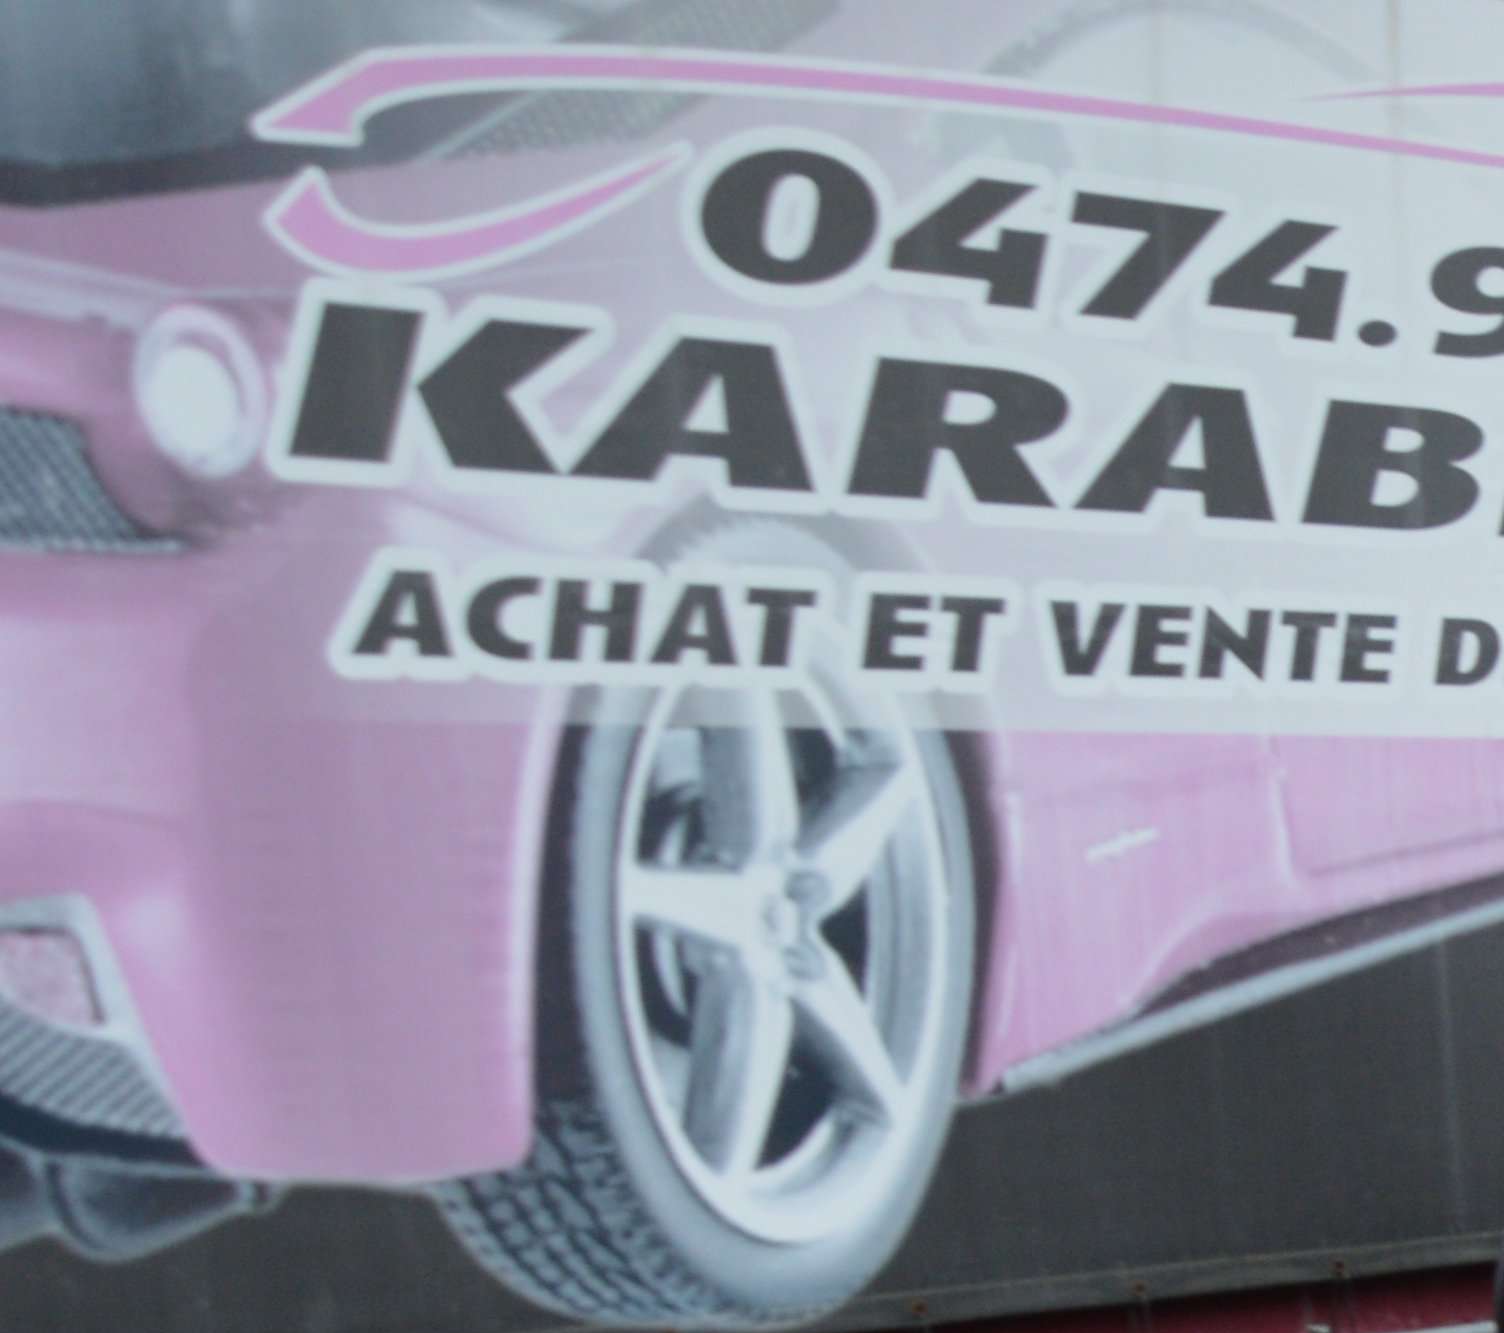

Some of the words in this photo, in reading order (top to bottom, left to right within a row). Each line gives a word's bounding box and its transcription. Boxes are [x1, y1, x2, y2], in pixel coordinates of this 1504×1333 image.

[348, 568, 817, 668] ACHAT
[860, 592, 1005, 675] ET
[1056, 599, 1397, 687] VENTE
